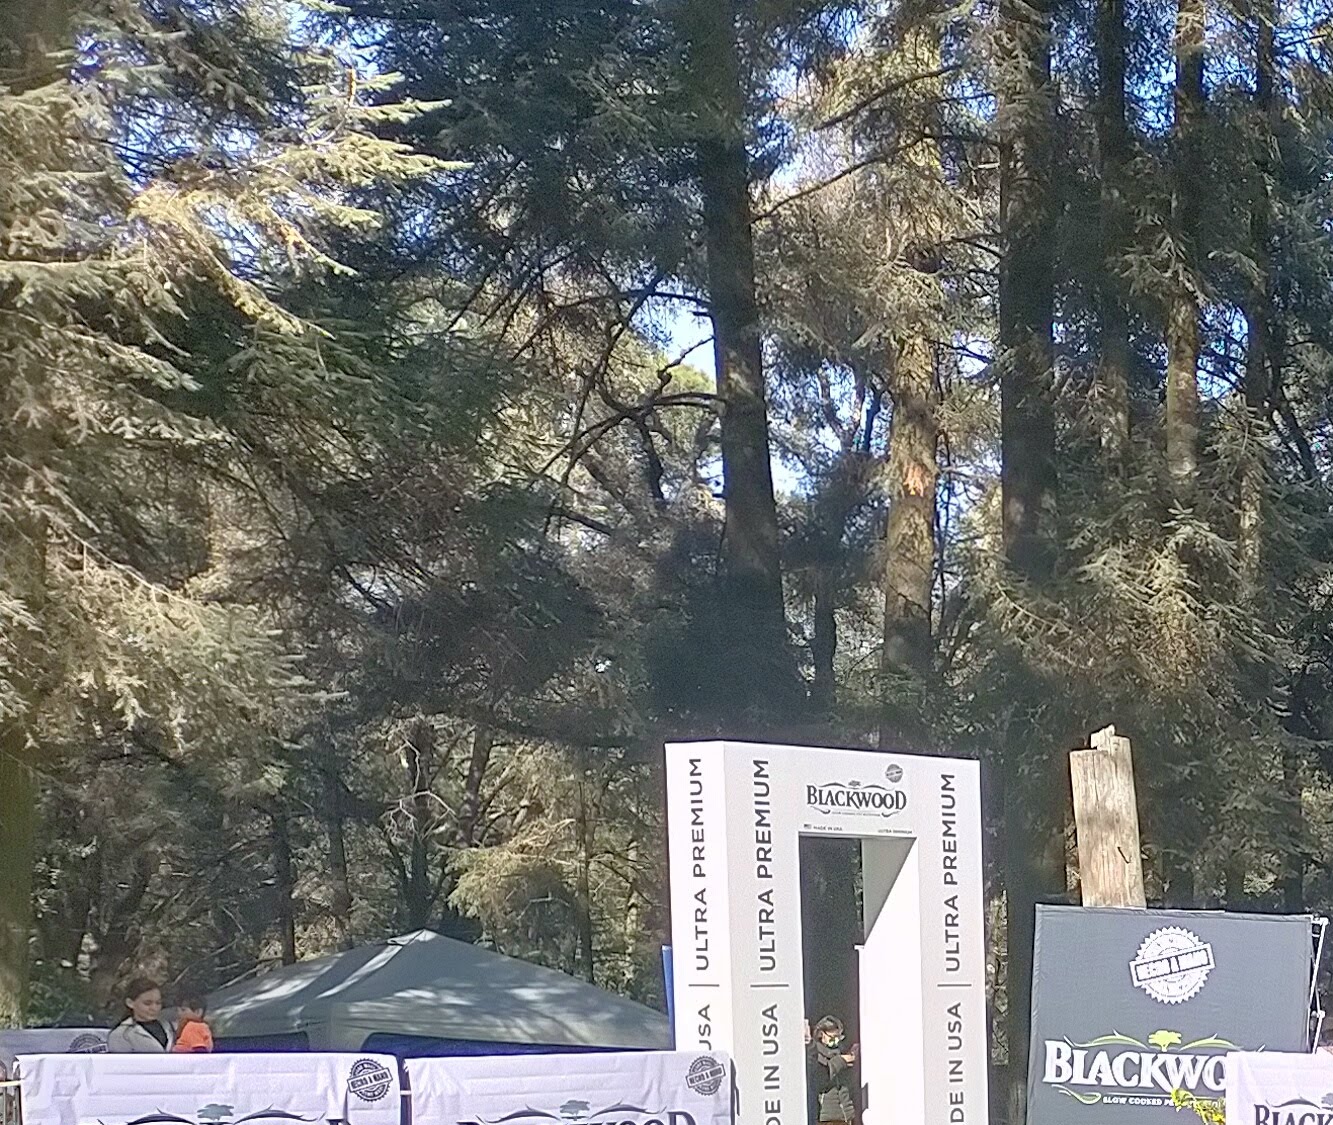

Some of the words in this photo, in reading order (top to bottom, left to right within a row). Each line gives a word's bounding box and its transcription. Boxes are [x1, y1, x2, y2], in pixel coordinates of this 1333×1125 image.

[688, 758, 706, 878] PREMIUM
[752, 759, 773, 879] PREMIUM
[806, 784, 907, 811] BLACKWOOD
[940, 774, 958, 885] PREMIUM
[693, 887, 710, 971] ULTRA
[757, 888, 777, 972] ULTRA
[943, 894, 960, 972] ULTRA
[761, 1004, 779, 1056] USA
[947, 1002, 962, 1051] USA
[763, 1065, 780, 1090] IN
[949, 1060, 963, 1083] IN
[1042, 1040, 1227, 1094] BLACKWO
